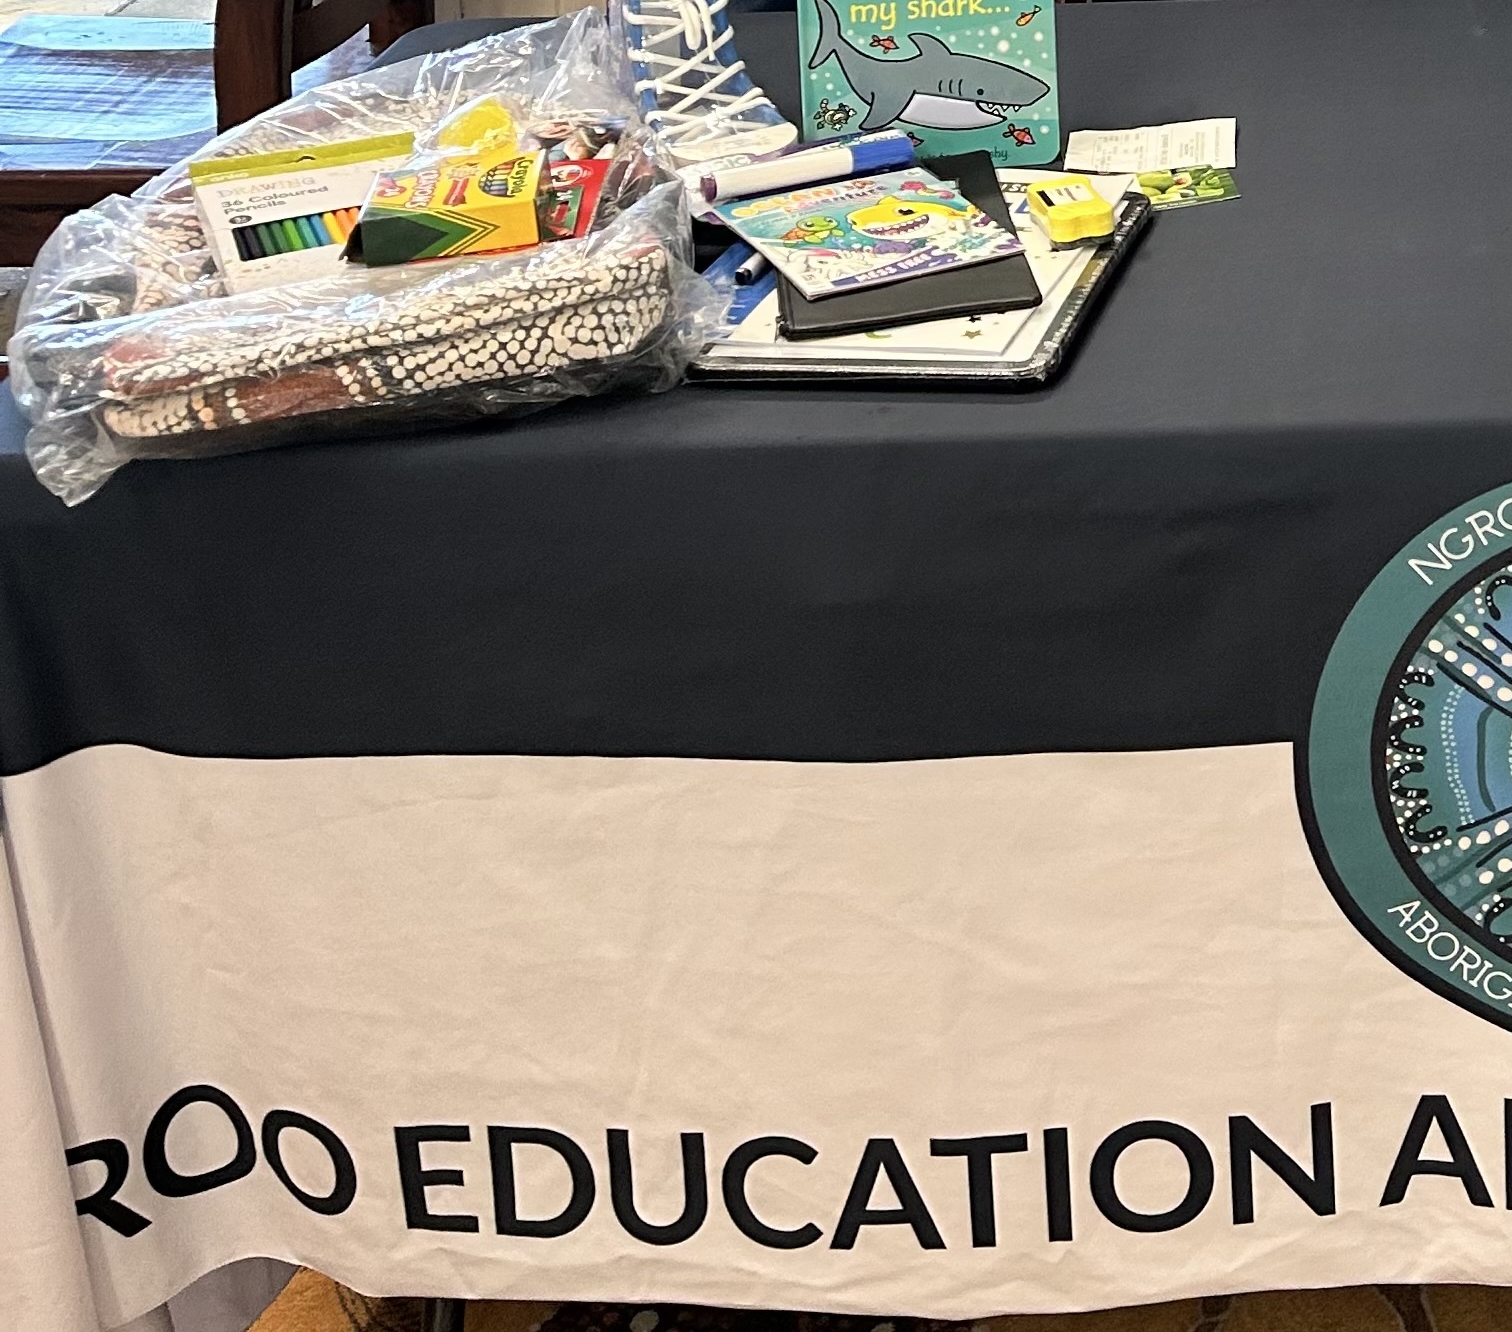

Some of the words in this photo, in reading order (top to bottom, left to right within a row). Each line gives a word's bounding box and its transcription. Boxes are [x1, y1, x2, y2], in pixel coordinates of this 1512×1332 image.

[850, 1, 898, 31] my
[216, 176, 317, 199] DRAWING
[404, 168, 441, 209] CRAYONS
[511, 158, 534, 196] Crayola
[221, 199, 244, 208] 36
[248, 185, 329, 203] Coloured
[224, 199, 287, 215] Pencils
[394, 1101, 1337, 1250] EDUCATION
